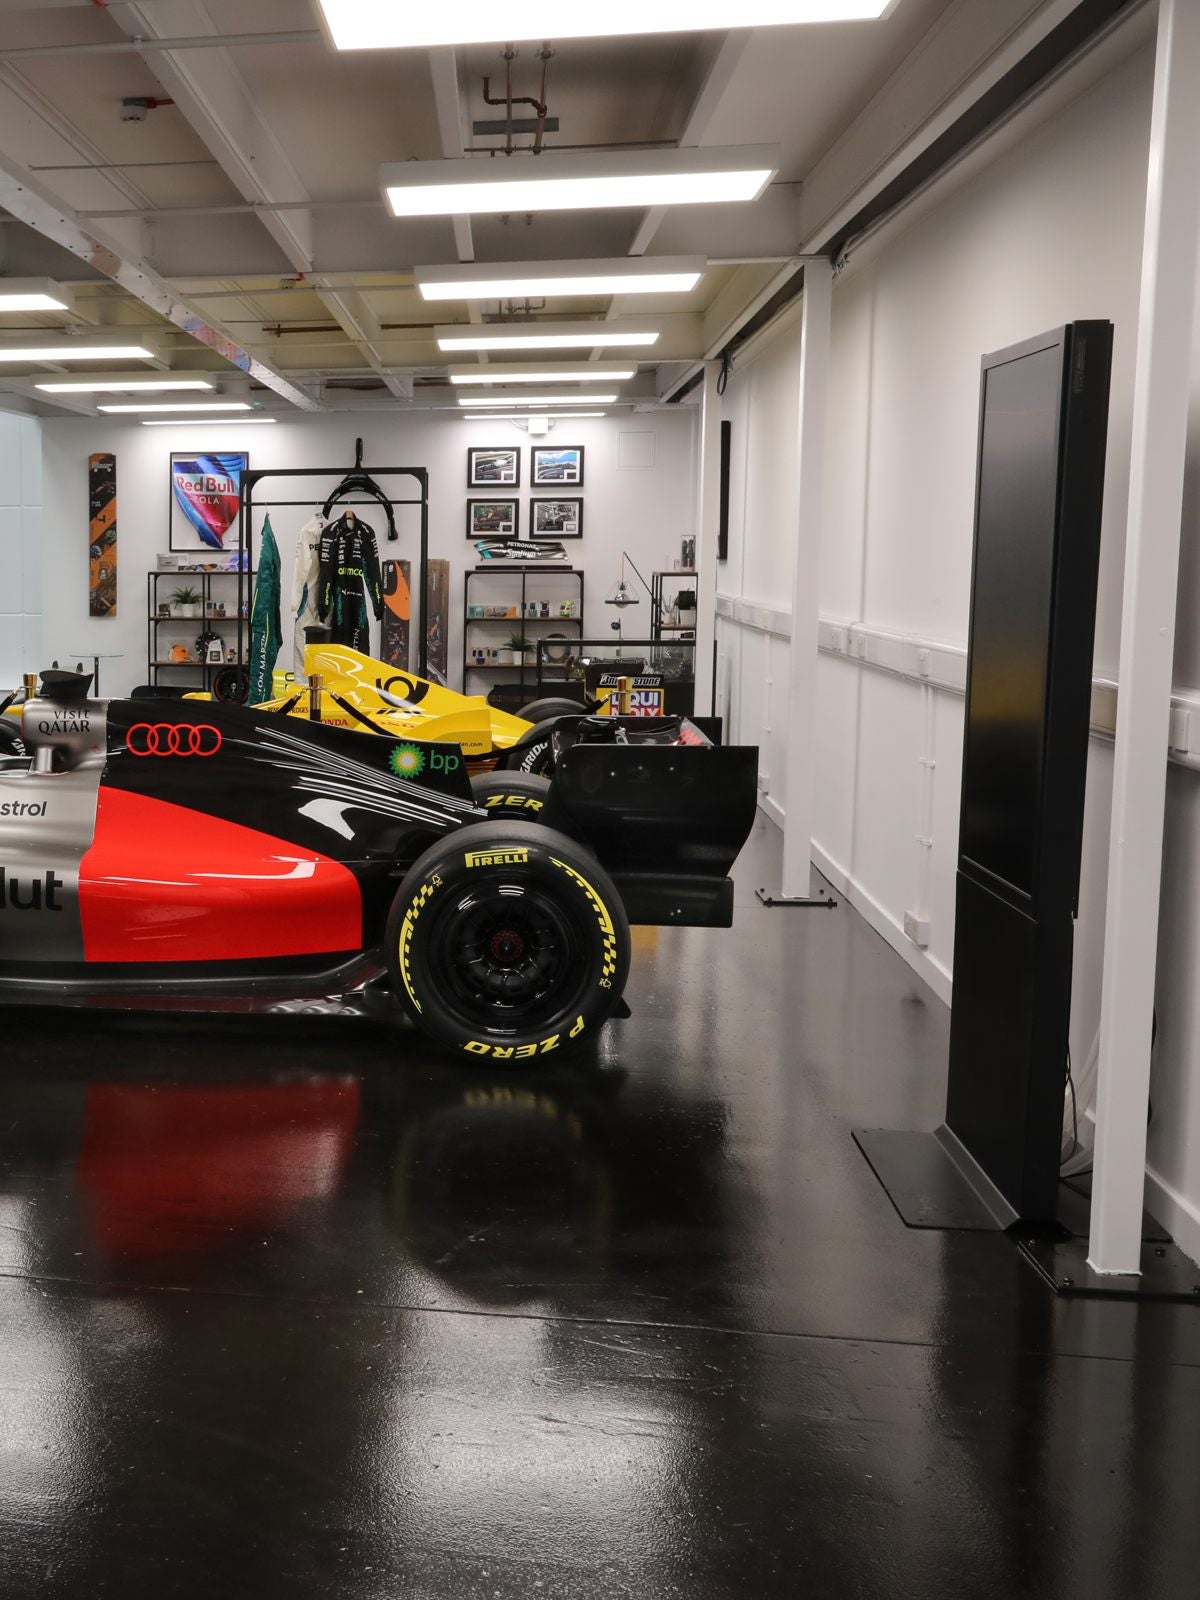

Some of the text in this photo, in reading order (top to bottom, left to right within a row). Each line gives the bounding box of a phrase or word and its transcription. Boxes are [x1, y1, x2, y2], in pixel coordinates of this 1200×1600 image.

[176, 477, 235, 493] Red Bull
[507, 541, 538, 549] PETRONAS
[611, 692, 659, 707] LQUI
[54, 707, 90, 720] visit
[38, 720, 91, 736] QATAR
[429, 749, 460, 775] bp
[464, 847, 529, 868] PIRELLI
[463, 1015, 585, 1059] P ZERO
